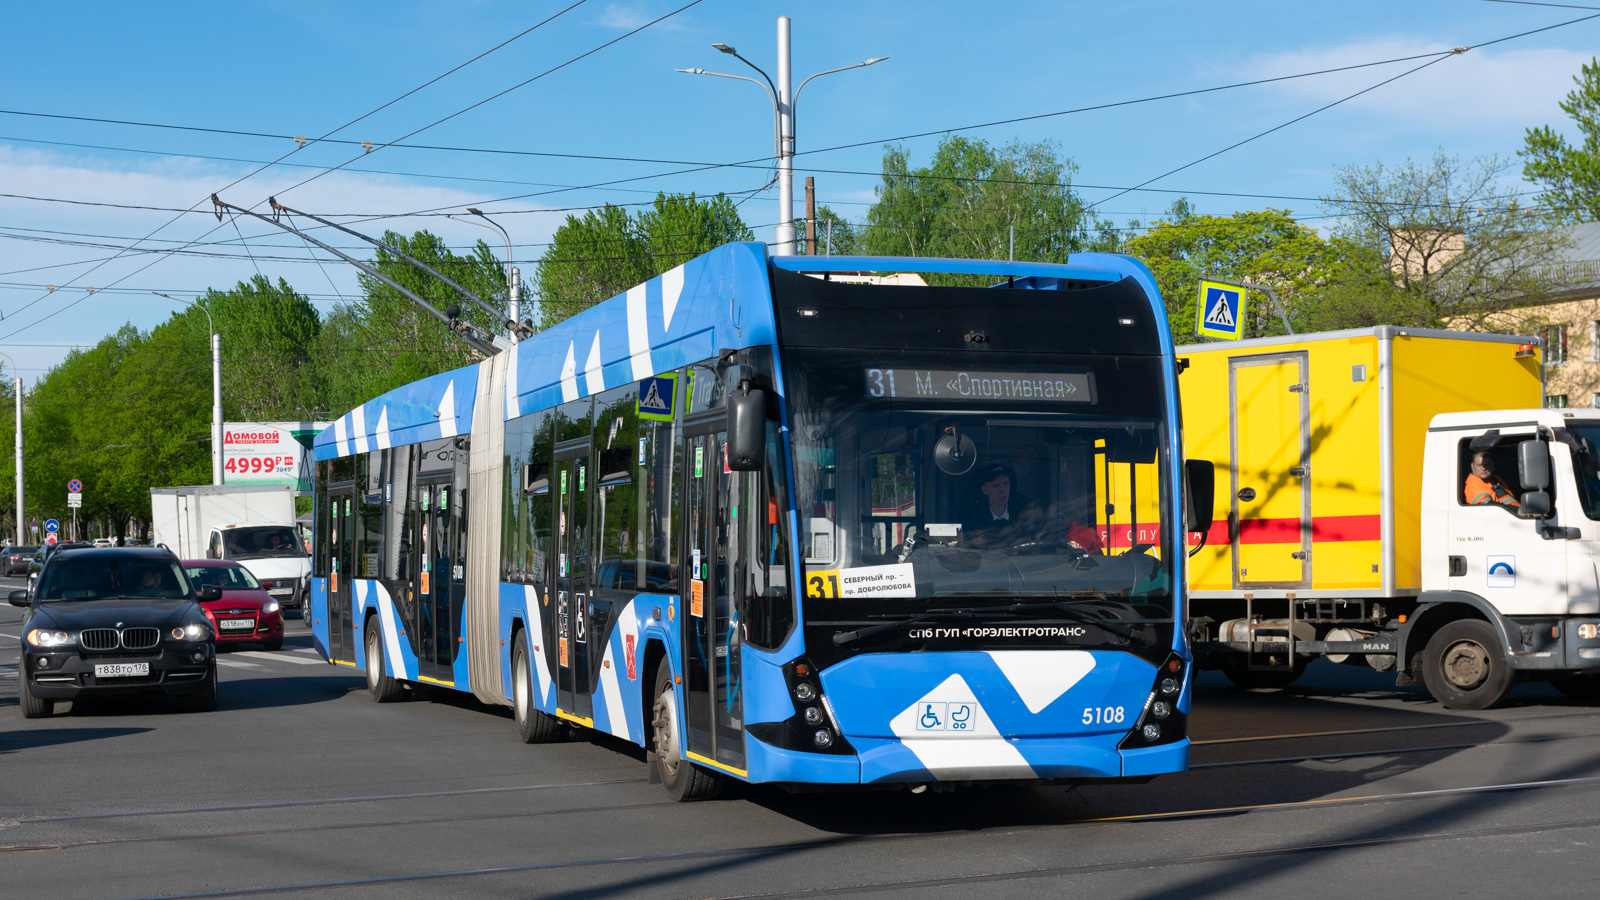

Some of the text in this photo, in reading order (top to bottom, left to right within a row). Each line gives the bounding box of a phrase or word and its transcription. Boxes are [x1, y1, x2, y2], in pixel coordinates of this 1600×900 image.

[868, 368, 1077, 399] 31 М. «Спортивная»
[224, 457, 275, 474] 4999
[843, 573, 883, 584] СЕВЕРНЫЙ
[809, 575, 839, 598] 31
[857, 583, 912, 594] ДОБРОЛЮБОВА
[935, 628, 960, 638] ГУП
[962, 627, 1086, 638] «ГОРЭЛЕКТРОТРАНС»
[133, 663, 147, 671] 178
[1081, 706, 1125, 725] 5108
